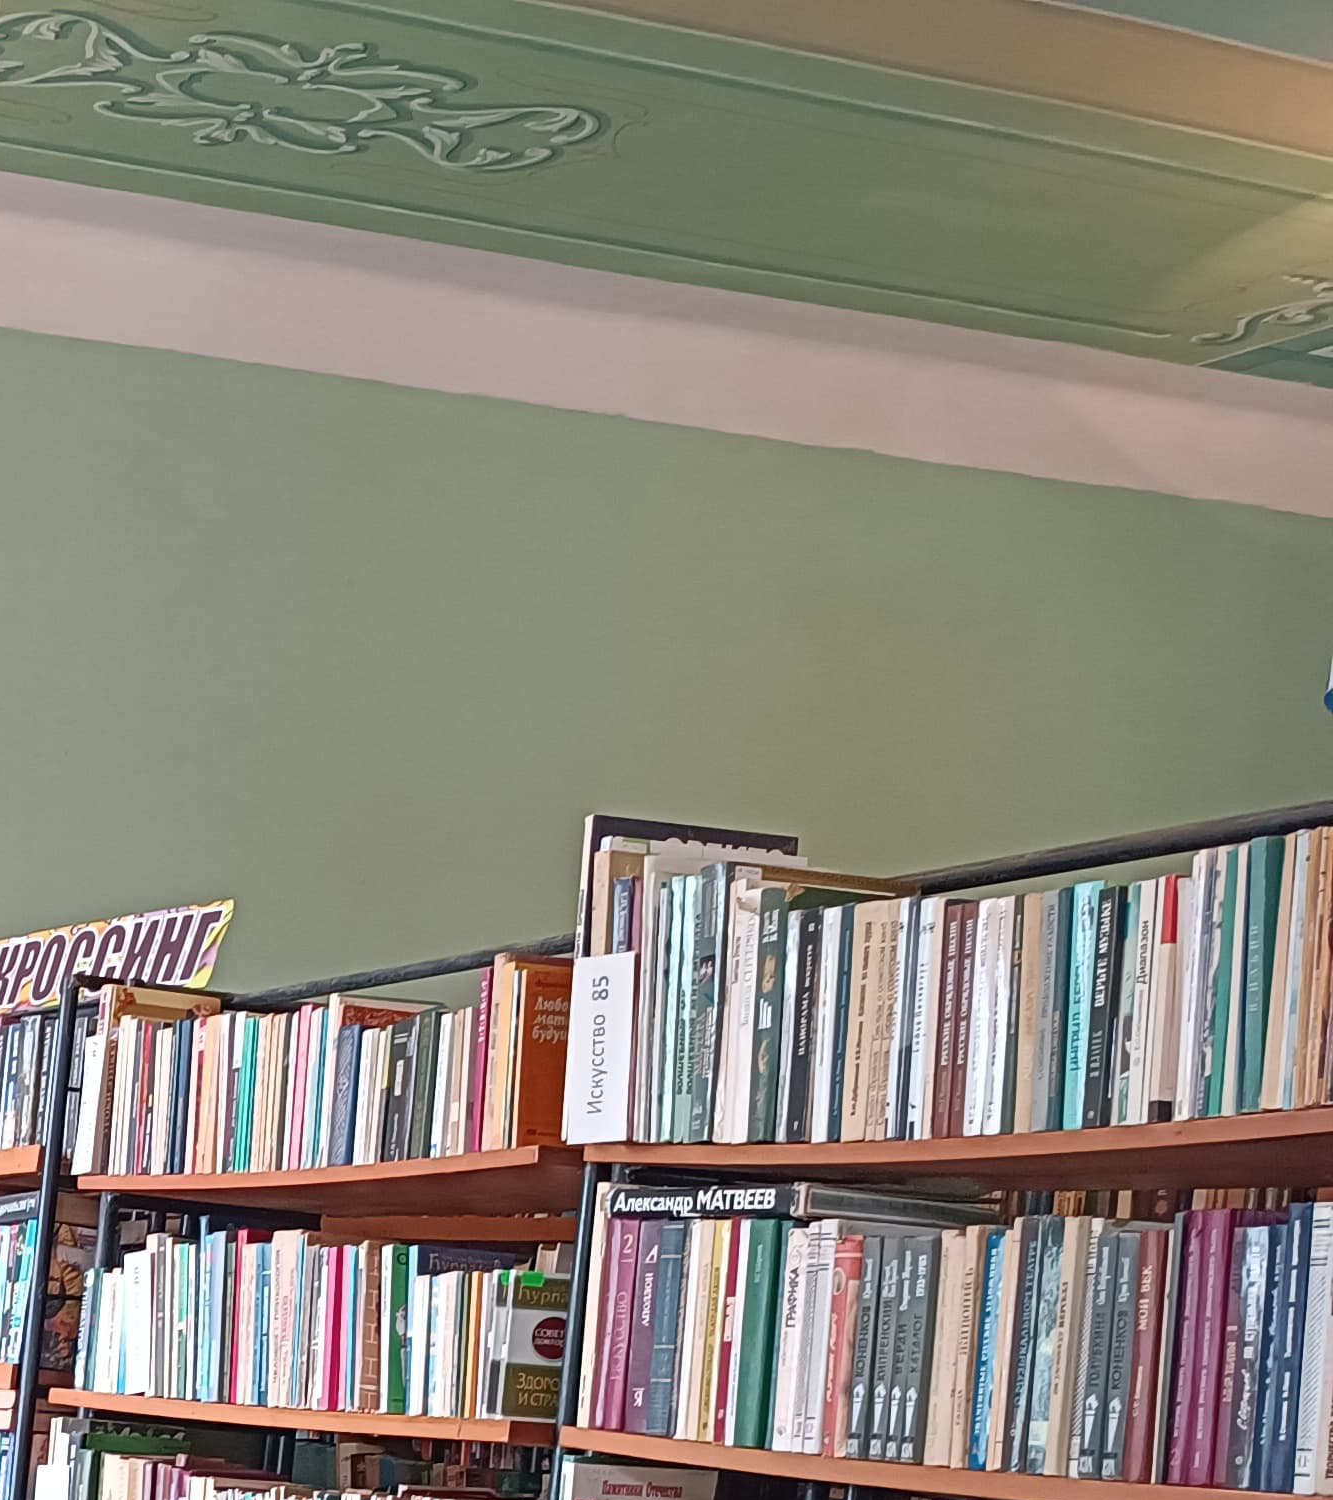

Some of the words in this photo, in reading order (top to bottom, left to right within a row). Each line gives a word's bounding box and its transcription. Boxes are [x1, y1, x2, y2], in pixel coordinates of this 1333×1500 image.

[1098, 898, 1113, 954] МУЗЫКЕ
[1135, 919, 1150, 986] Диапазон
[534, 996, 569, 1014] Любо
[591, 974, 610, 1002] 85
[1093, 957, 1108, 1008] ВЕРЬТЕ
[533, 1013, 569, 1028] мат
[797, 991, 811, 1057] ПАНОРАМА
[939, 1020, 952, 1067] РУССКИЕ
[956, 1019, 968, 1065] РУССКИЕ
[586, 1013, 609, 1115] Искусство
[612, 1191, 694, 1216] Александр
[695, 1187, 777, 1212] МАТВЕЕВ
[622, 1233, 634, 1255] 2
[784, 1266, 801, 1329] ГРАФИКА
[1138, 1264, 1153, 1294] ВЕК
[534, 1326, 565, 1338] СОВЕТ
[1136, 1298, 1151, 1331] МОЙ
[854, 1305, 872, 1378] КОНЕНКОВ
[908, 1312, 923, 1374] КАТАЛОГ
[1109, 1309, 1129, 1391] КОНЕНКОВ
[516, 1373, 561, 1393] ЗДОРО
[529, 1392, 561, 1408] СТРА
